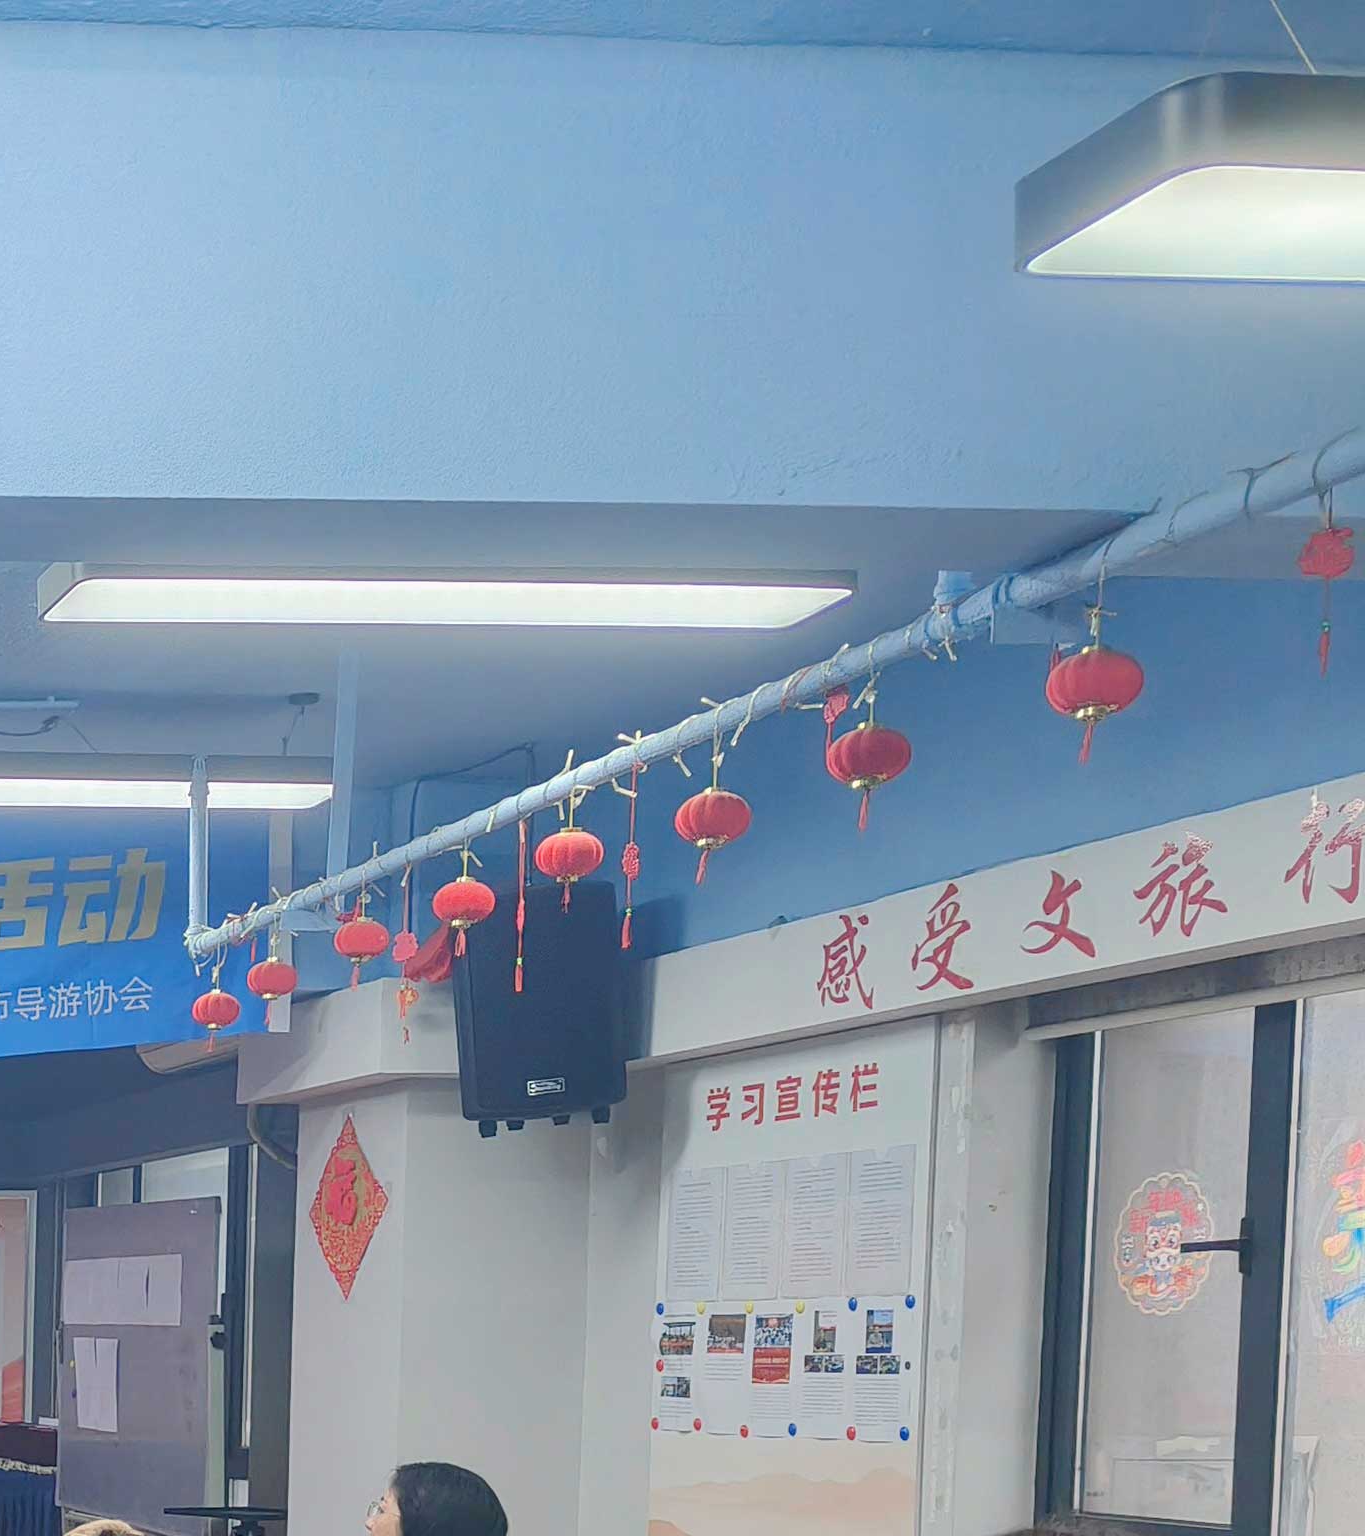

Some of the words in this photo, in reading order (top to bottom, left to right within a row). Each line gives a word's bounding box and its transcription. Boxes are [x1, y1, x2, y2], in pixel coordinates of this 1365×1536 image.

[706, 1062, 880, 1131] 学习宣传栏
